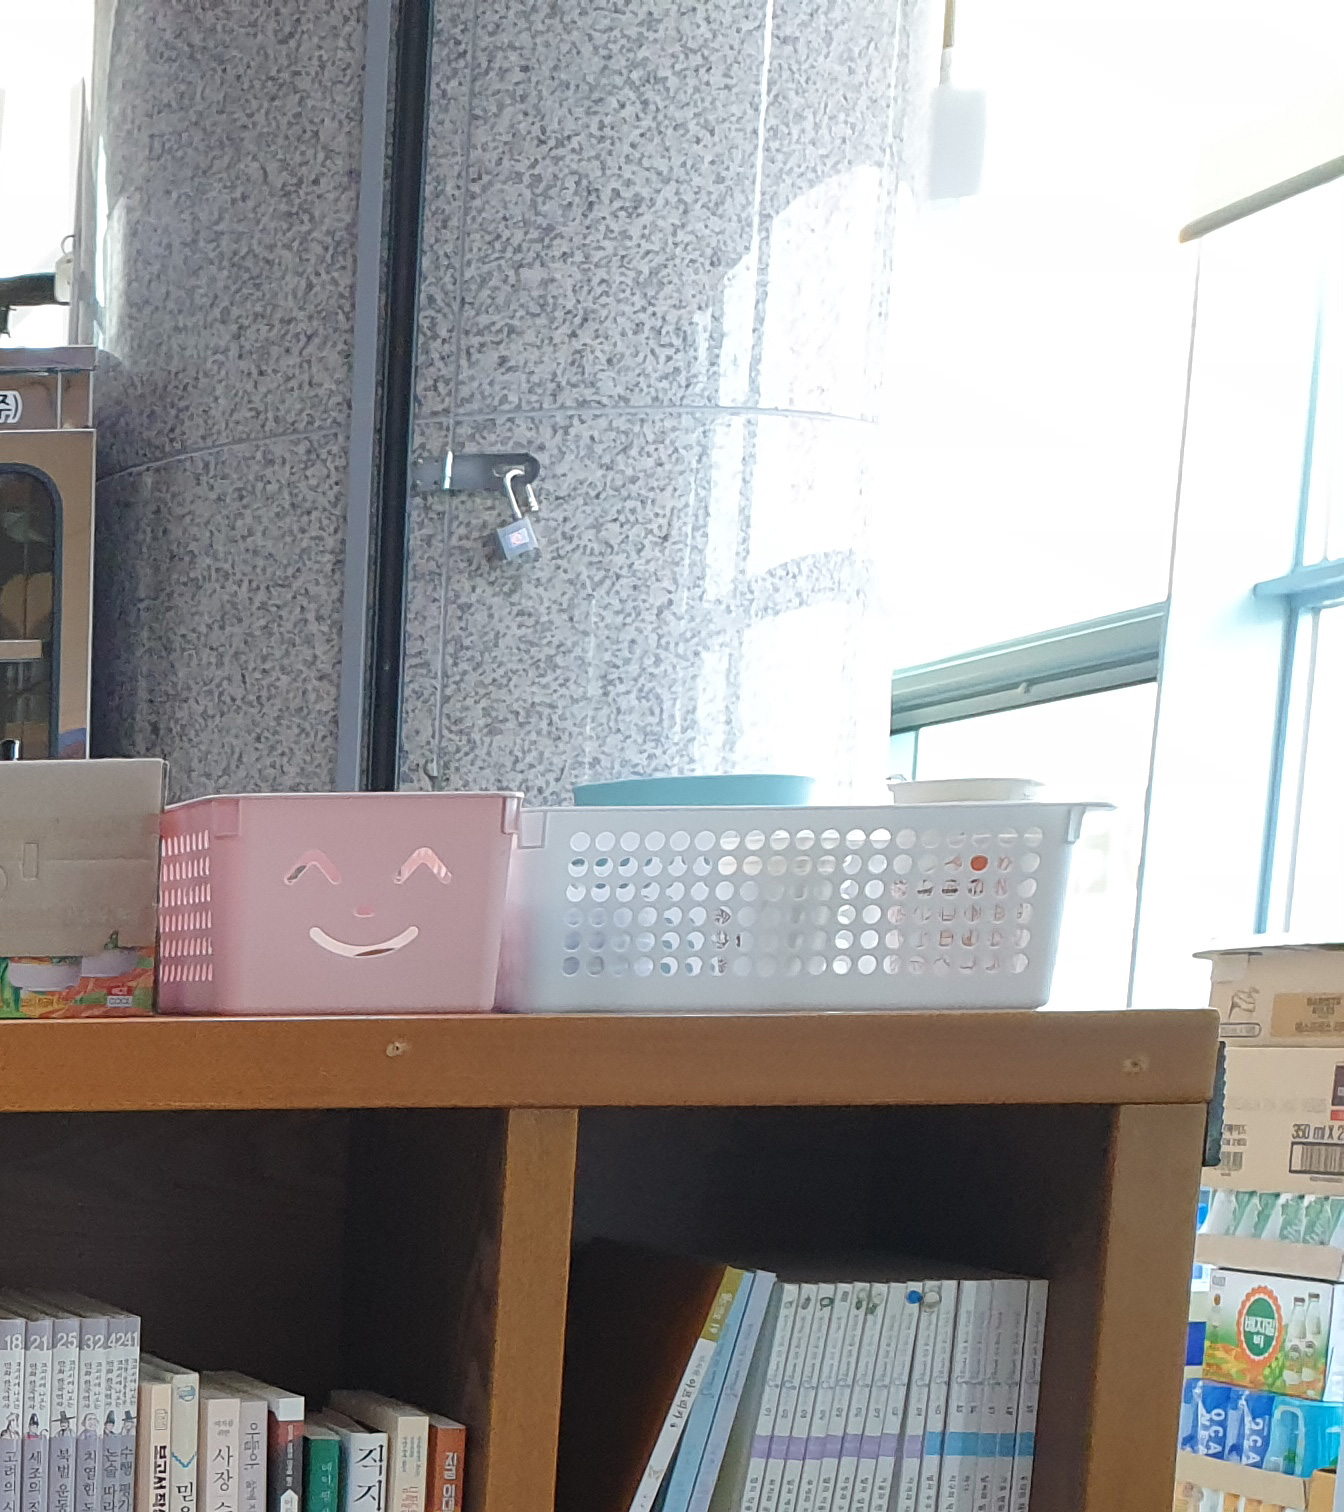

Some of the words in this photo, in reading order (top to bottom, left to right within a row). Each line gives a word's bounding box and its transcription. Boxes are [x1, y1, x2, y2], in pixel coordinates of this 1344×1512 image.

[1292, 1124, 1310, 1139] 350
[153, 1445, 167, 1489] 보고서
[212, 1445, 233, 1492] 사장
[354, 1444, 384, 1512] 직지
